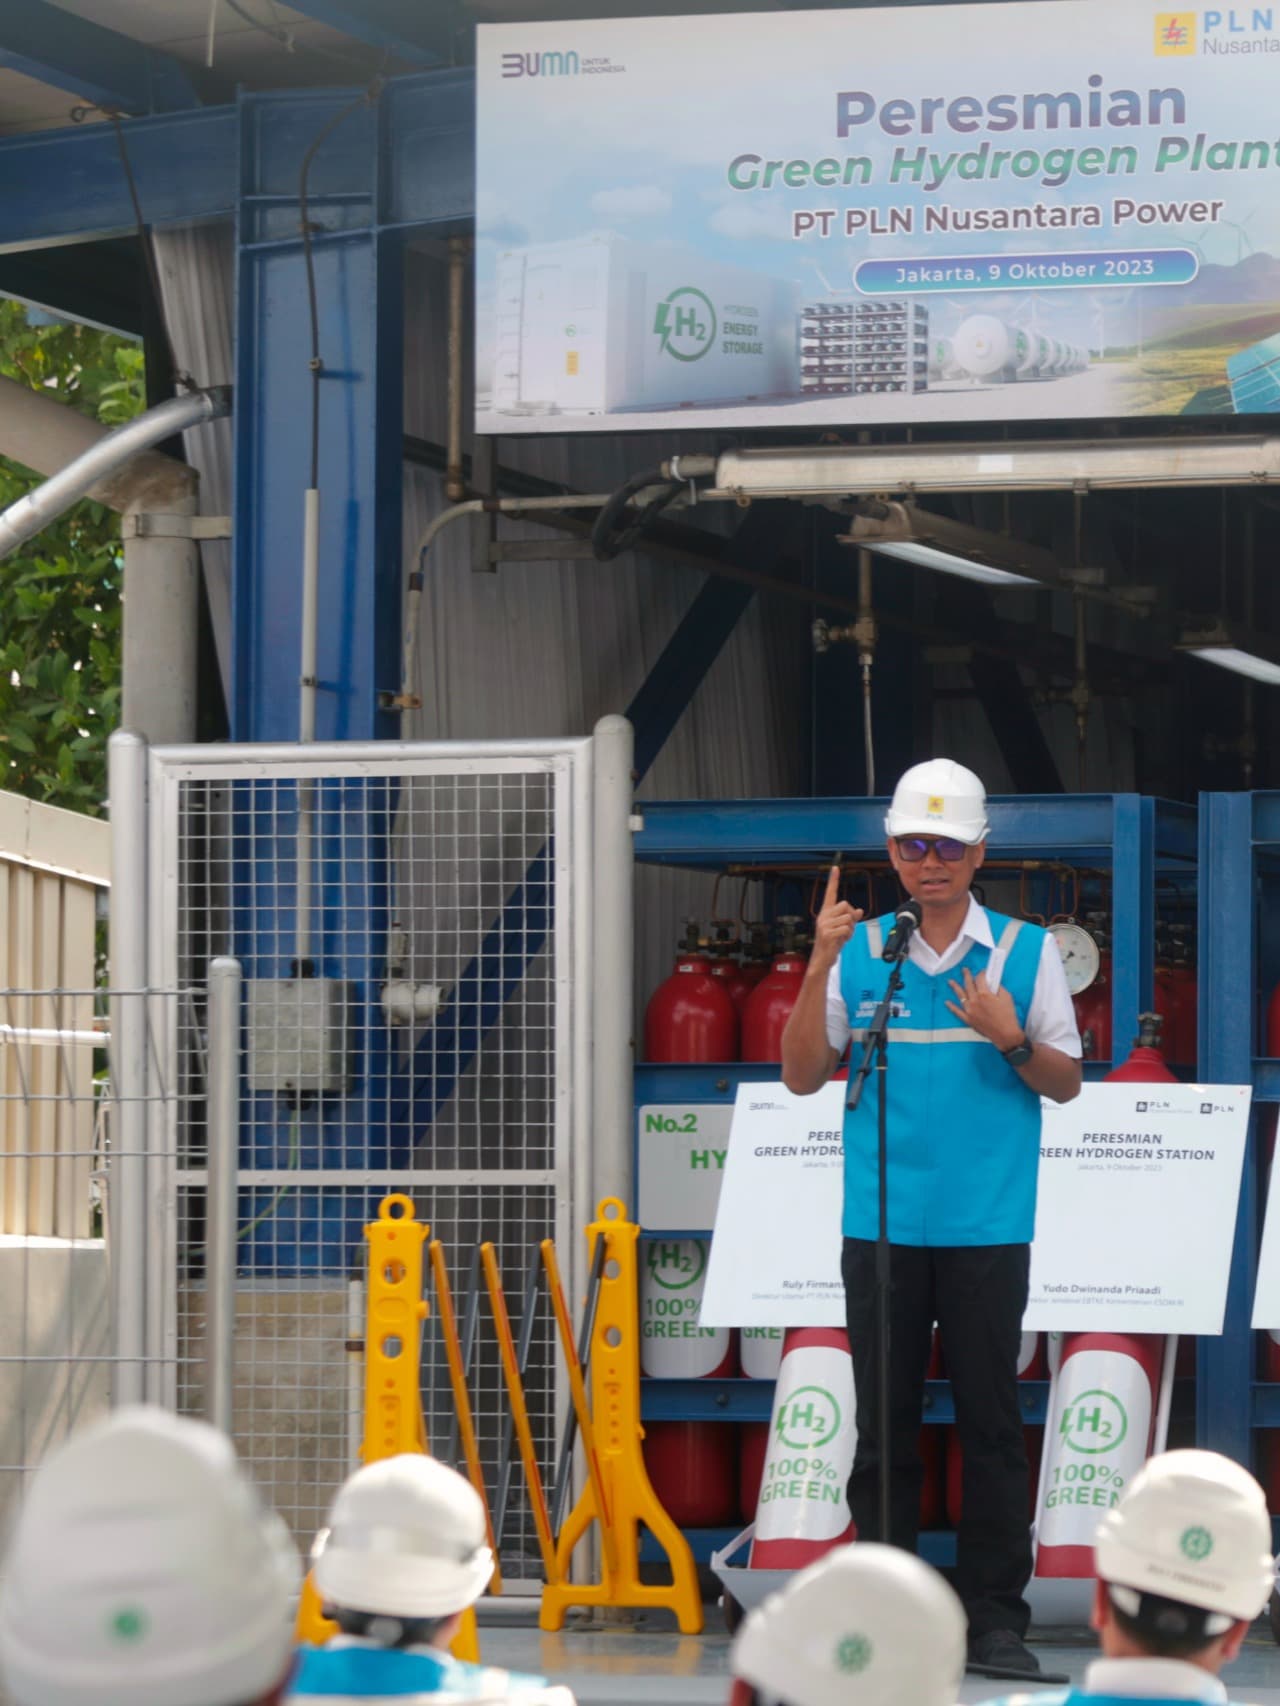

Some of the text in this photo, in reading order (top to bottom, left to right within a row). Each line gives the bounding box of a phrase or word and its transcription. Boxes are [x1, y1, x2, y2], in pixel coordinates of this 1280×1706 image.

[1204, 9, 1274, 33] PLN
[836, 73, 1186, 138] Peresmian
[727, 153, 873, 191] Green
[890, 142, 1138, 192] Hydrogen
[793, 199, 1223, 238] PT PLN Nusantara Power
[896, 259, 1155, 284] Jakarta, 9 Oktober 2023
[674, 305, 706, 341] H2
[722, 321, 759, 337] ENERGY
[722, 341, 764, 355] STORAGE
[1149, 1101, 1170, 1109] PLN
[1213, 1105, 1235, 1113] PLN
[645, 1113, 698, 1133] No.2
[808, 1131, 842, 1141] PERE
[1082, 1133, 1163, 1145] PERESMIAN
[690, 1149, 728, 1169] HY
[754, 1146, 846, 1157] GREEN HYDRO
[1039, 1147, 1215, 1161] REEN HYDROGEN STATION
[660, 1243, 692, 1273] H2
[782, 1279, 804, 1291] Ruly
[1070, 1284, 1123, 1295] Dwinanda
[1125, 1285, 1162, 1296] Priaadi
[743, 1327, 782, 1339] GRE
[791, 1402, 826, 1433] H2
[1076, 1408, 1112, 1439] H2
[768, 1458, 838, 1481] 100%
[1053, 1463, 1124, 1488] 100%
[760, 1480, 842, 1505] GREEN
